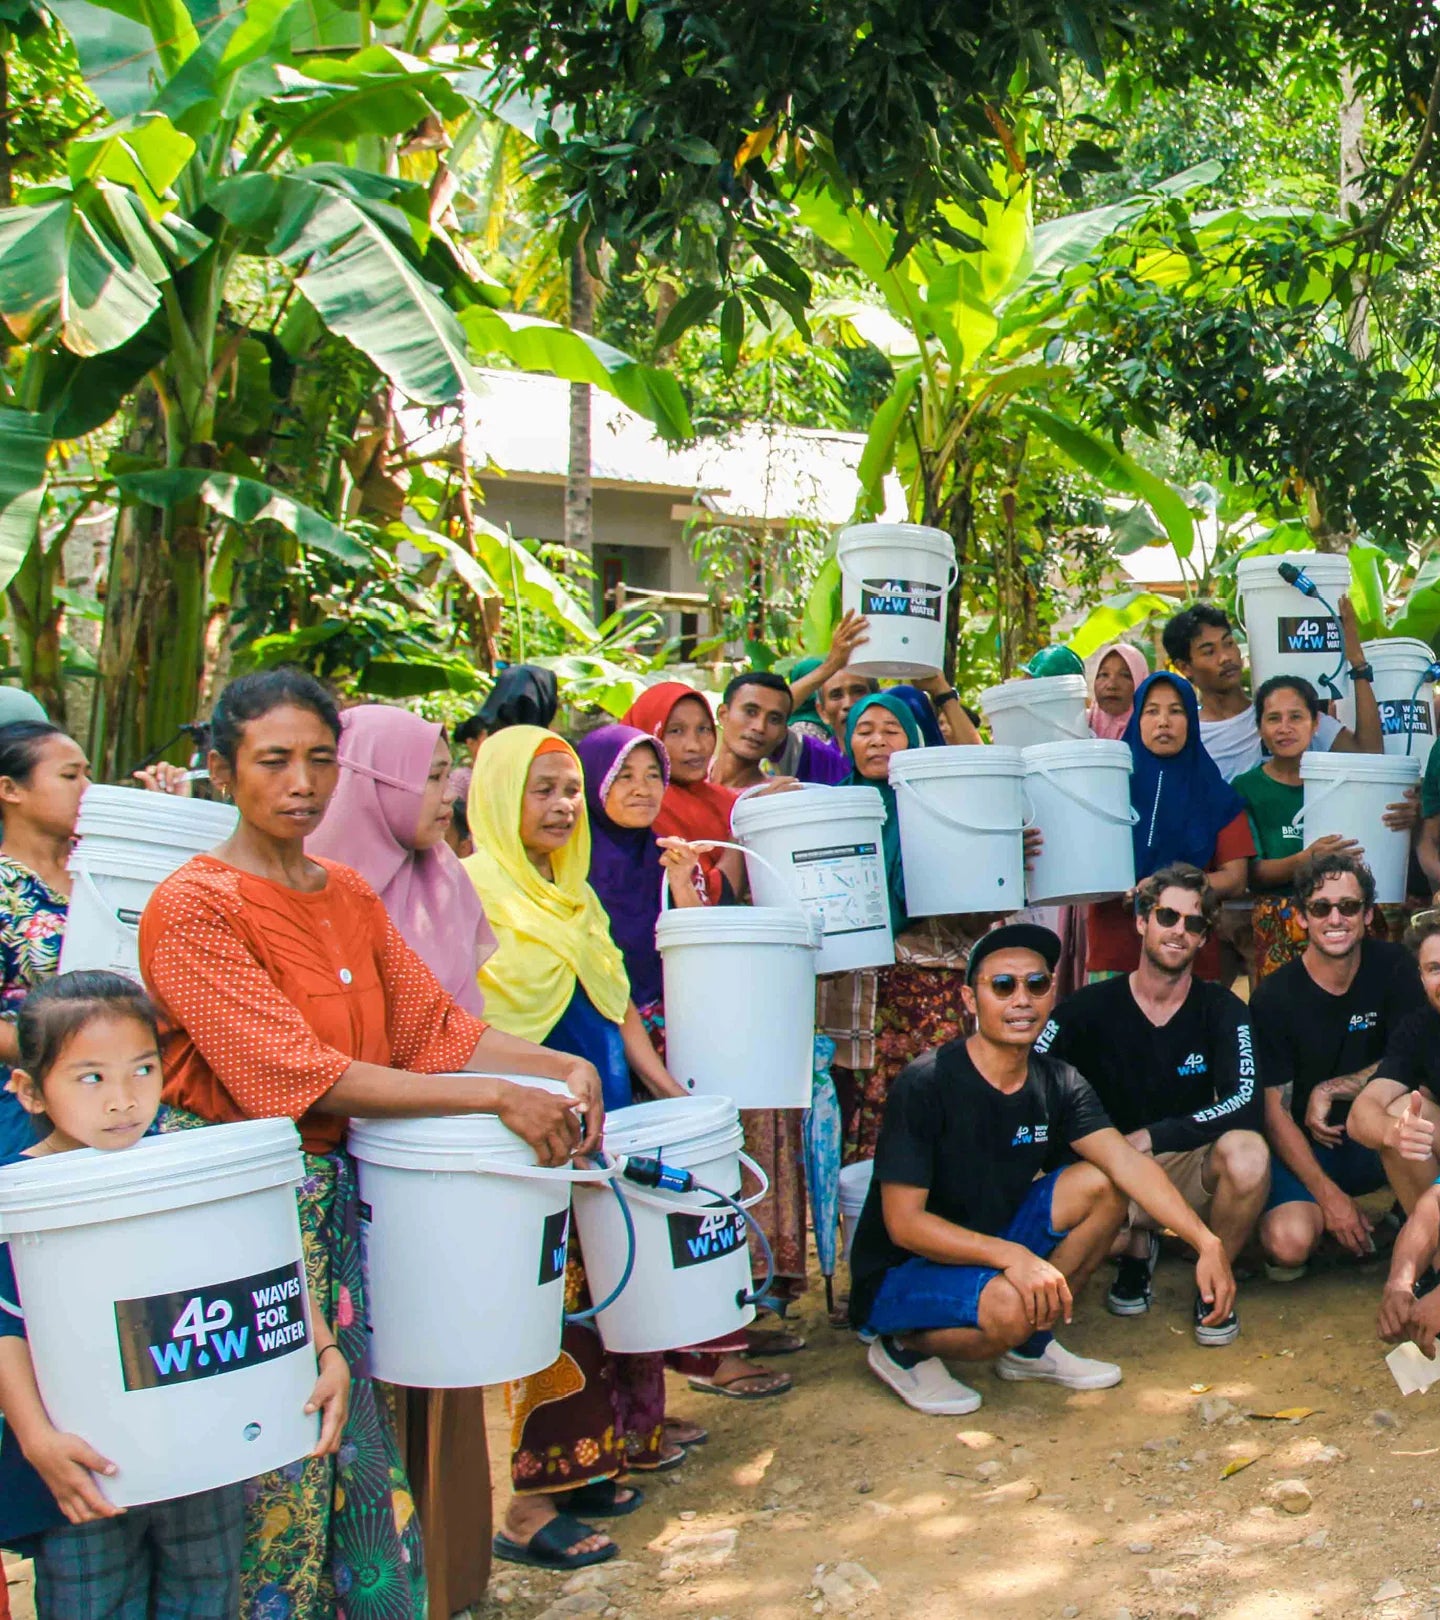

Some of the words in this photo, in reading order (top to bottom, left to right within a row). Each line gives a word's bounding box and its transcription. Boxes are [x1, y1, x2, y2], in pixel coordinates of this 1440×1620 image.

[910, 605, 935, 616] WATER
[1034, 1019, 1060, 1054] ATER
[1237, 1024, 1255, 1076] WAVES
[1192, 1095, 1246, 1123] WATER
[252, 1277, 301, 1309] WAVES
[256, 1305, 289, 1332] FOR
[257, 1321, 306, 1353] WATER
